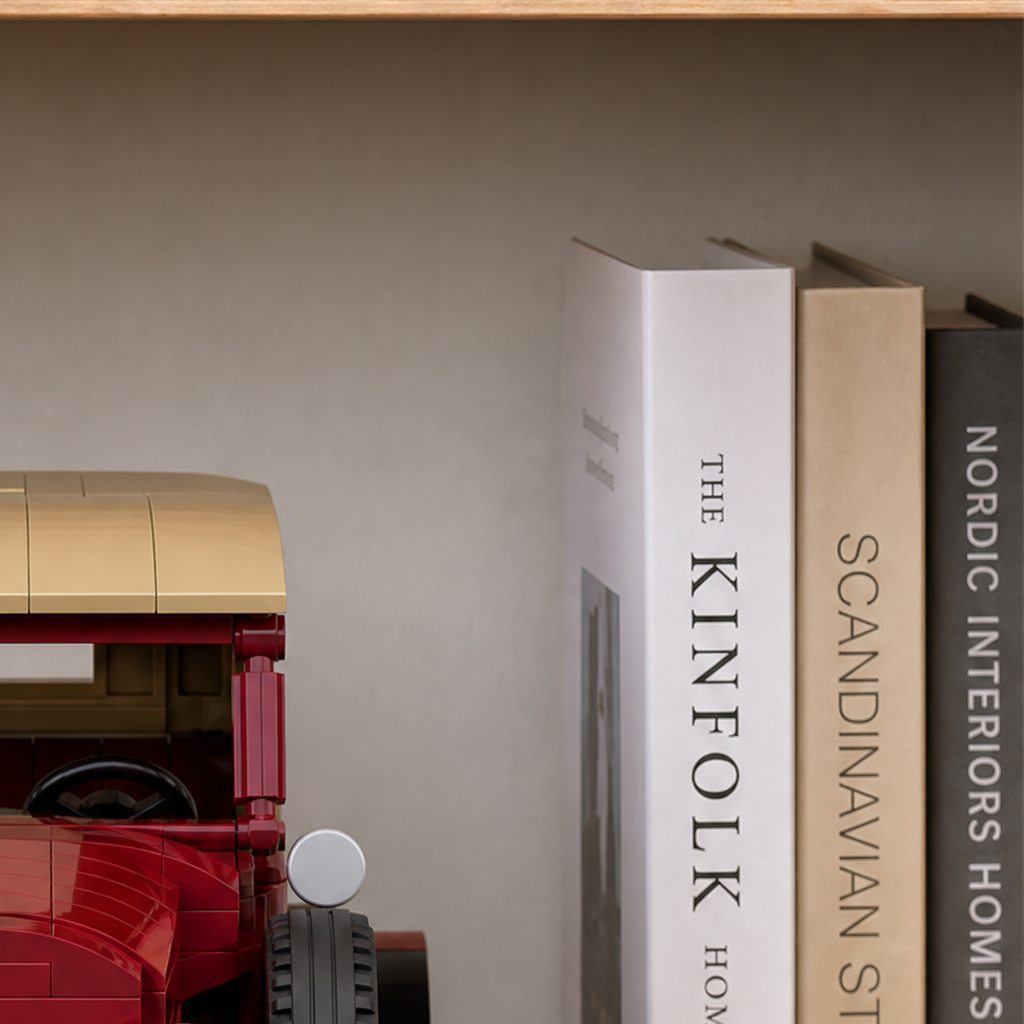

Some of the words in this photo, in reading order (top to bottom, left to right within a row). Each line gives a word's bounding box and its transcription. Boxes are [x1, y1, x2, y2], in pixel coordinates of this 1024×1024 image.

[700, 452, 725, 524] THE
[966, 425, 1000, 593] NORDIC
[690, 551, 742, 913] KINFOLK
[836, 532, 880, 939] SCANDINAVIAN
[967, 615, 1002, 843] INTERIORS
[968, 862, 1003, 1021] HOMES
